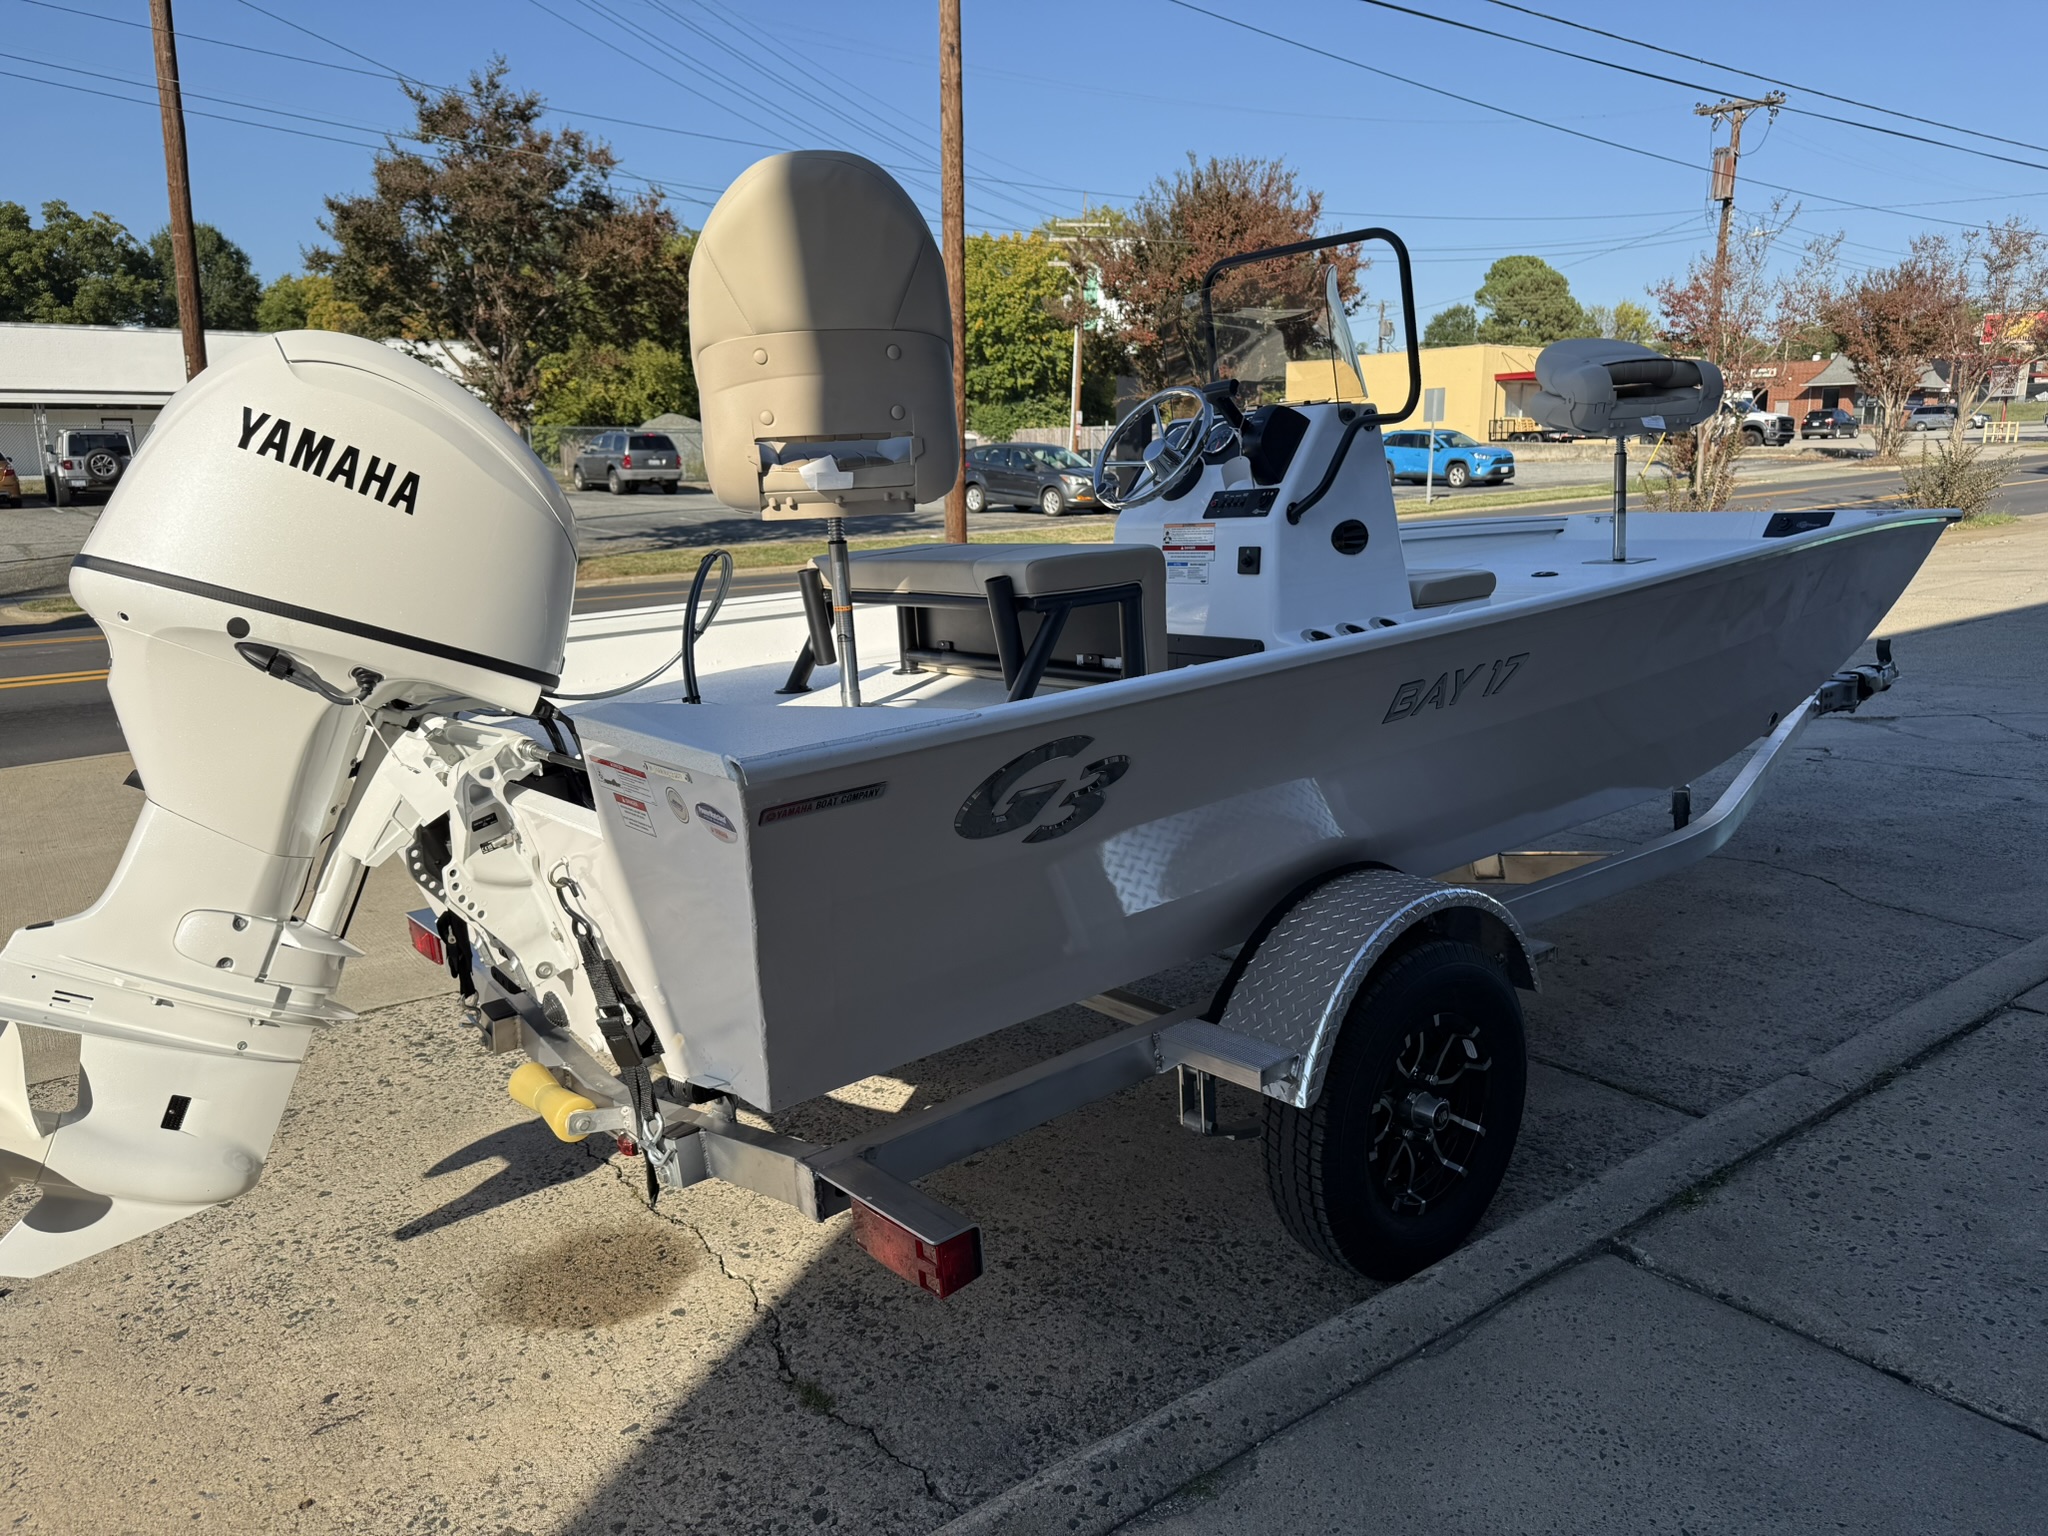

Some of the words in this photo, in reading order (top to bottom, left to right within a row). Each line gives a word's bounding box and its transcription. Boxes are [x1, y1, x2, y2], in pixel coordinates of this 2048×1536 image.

[238, 406, 421, 515] YAMAHA
[1382, 663, 1485, 724] BAY
[1482, 652, 1530, 697] 17
[776, 803, 813, 820] YAMAHA
[815, 797, 839, 811] BOAT
[840, 787, 881, 804] COMPANY
[954, 735, 1131, 843] G3
